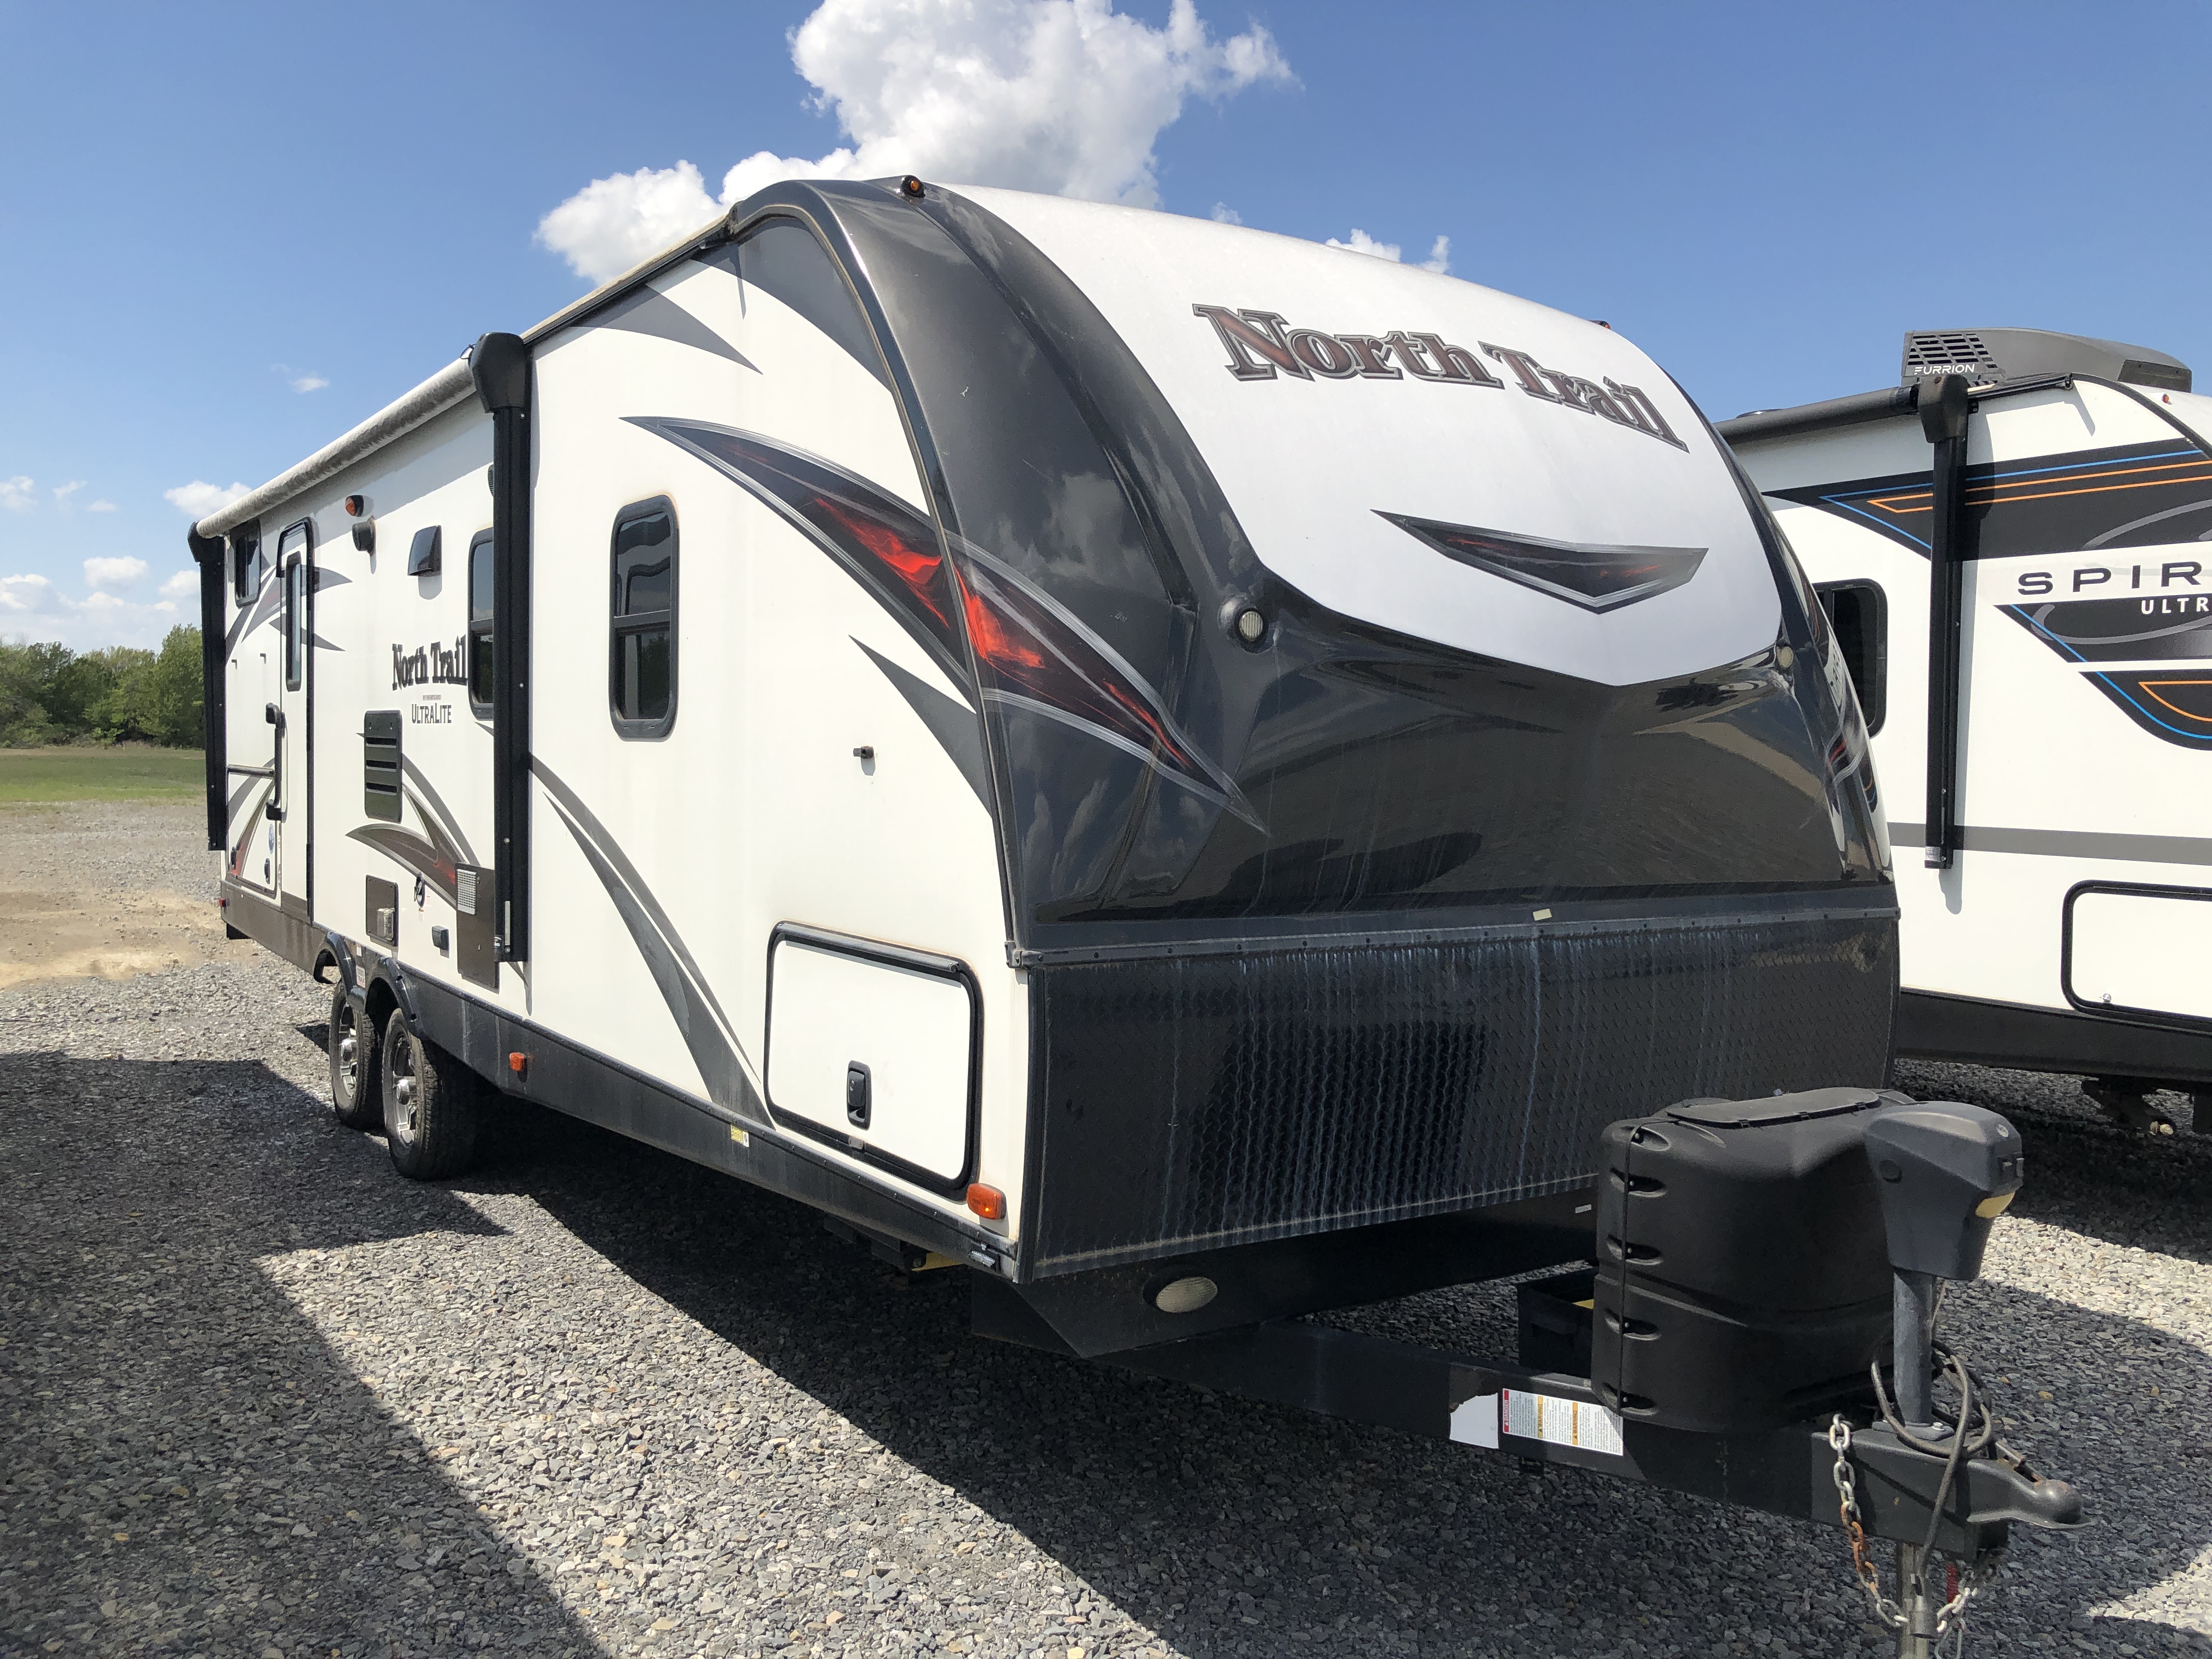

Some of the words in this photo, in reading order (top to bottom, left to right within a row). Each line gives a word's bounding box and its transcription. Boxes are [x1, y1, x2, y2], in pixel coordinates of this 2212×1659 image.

[1192, 303, 1505, 390] North
[1477, 341, 1690, 454] Trail
[1914, 364, 1975, 375] FURRION
[2018, 561, 2203, 595] SPIR
[2141, 597, 2210, 614] ULTR
[392, 644, 429, 691] North
[431, 634, 468, 686] Trail
